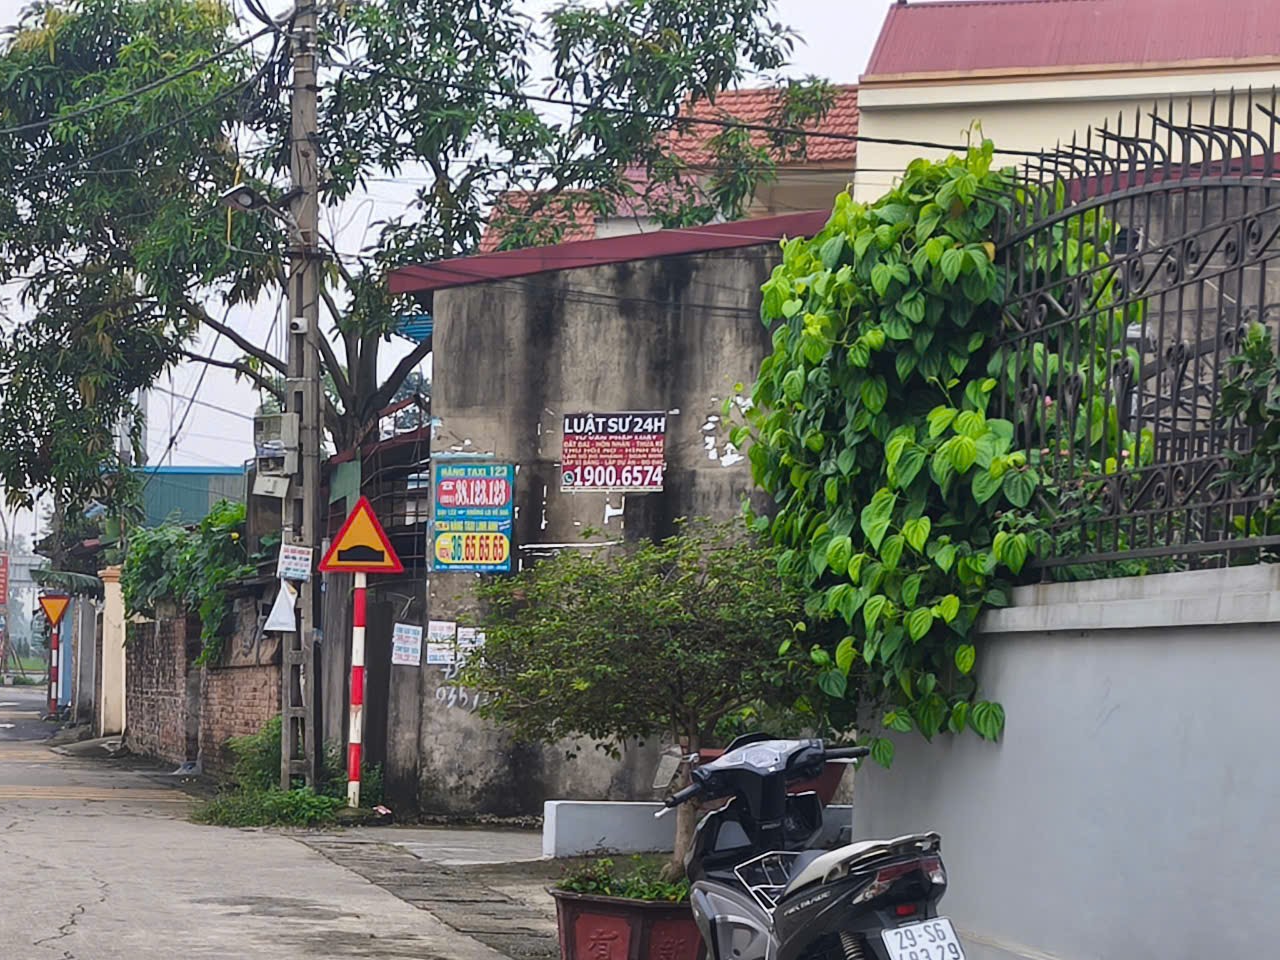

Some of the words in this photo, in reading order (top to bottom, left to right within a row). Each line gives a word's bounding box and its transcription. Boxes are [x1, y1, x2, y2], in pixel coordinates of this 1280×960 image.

[564, 413, 606, 435] LUẬT
[607, 415, 632, 433] SƯ
[633, 417, 665, 433] 24H
[490, 466, 508, 477] 123
[574, 465, 663, 486] 1900.6574
[894, 922, 947, 950] 29-S6
